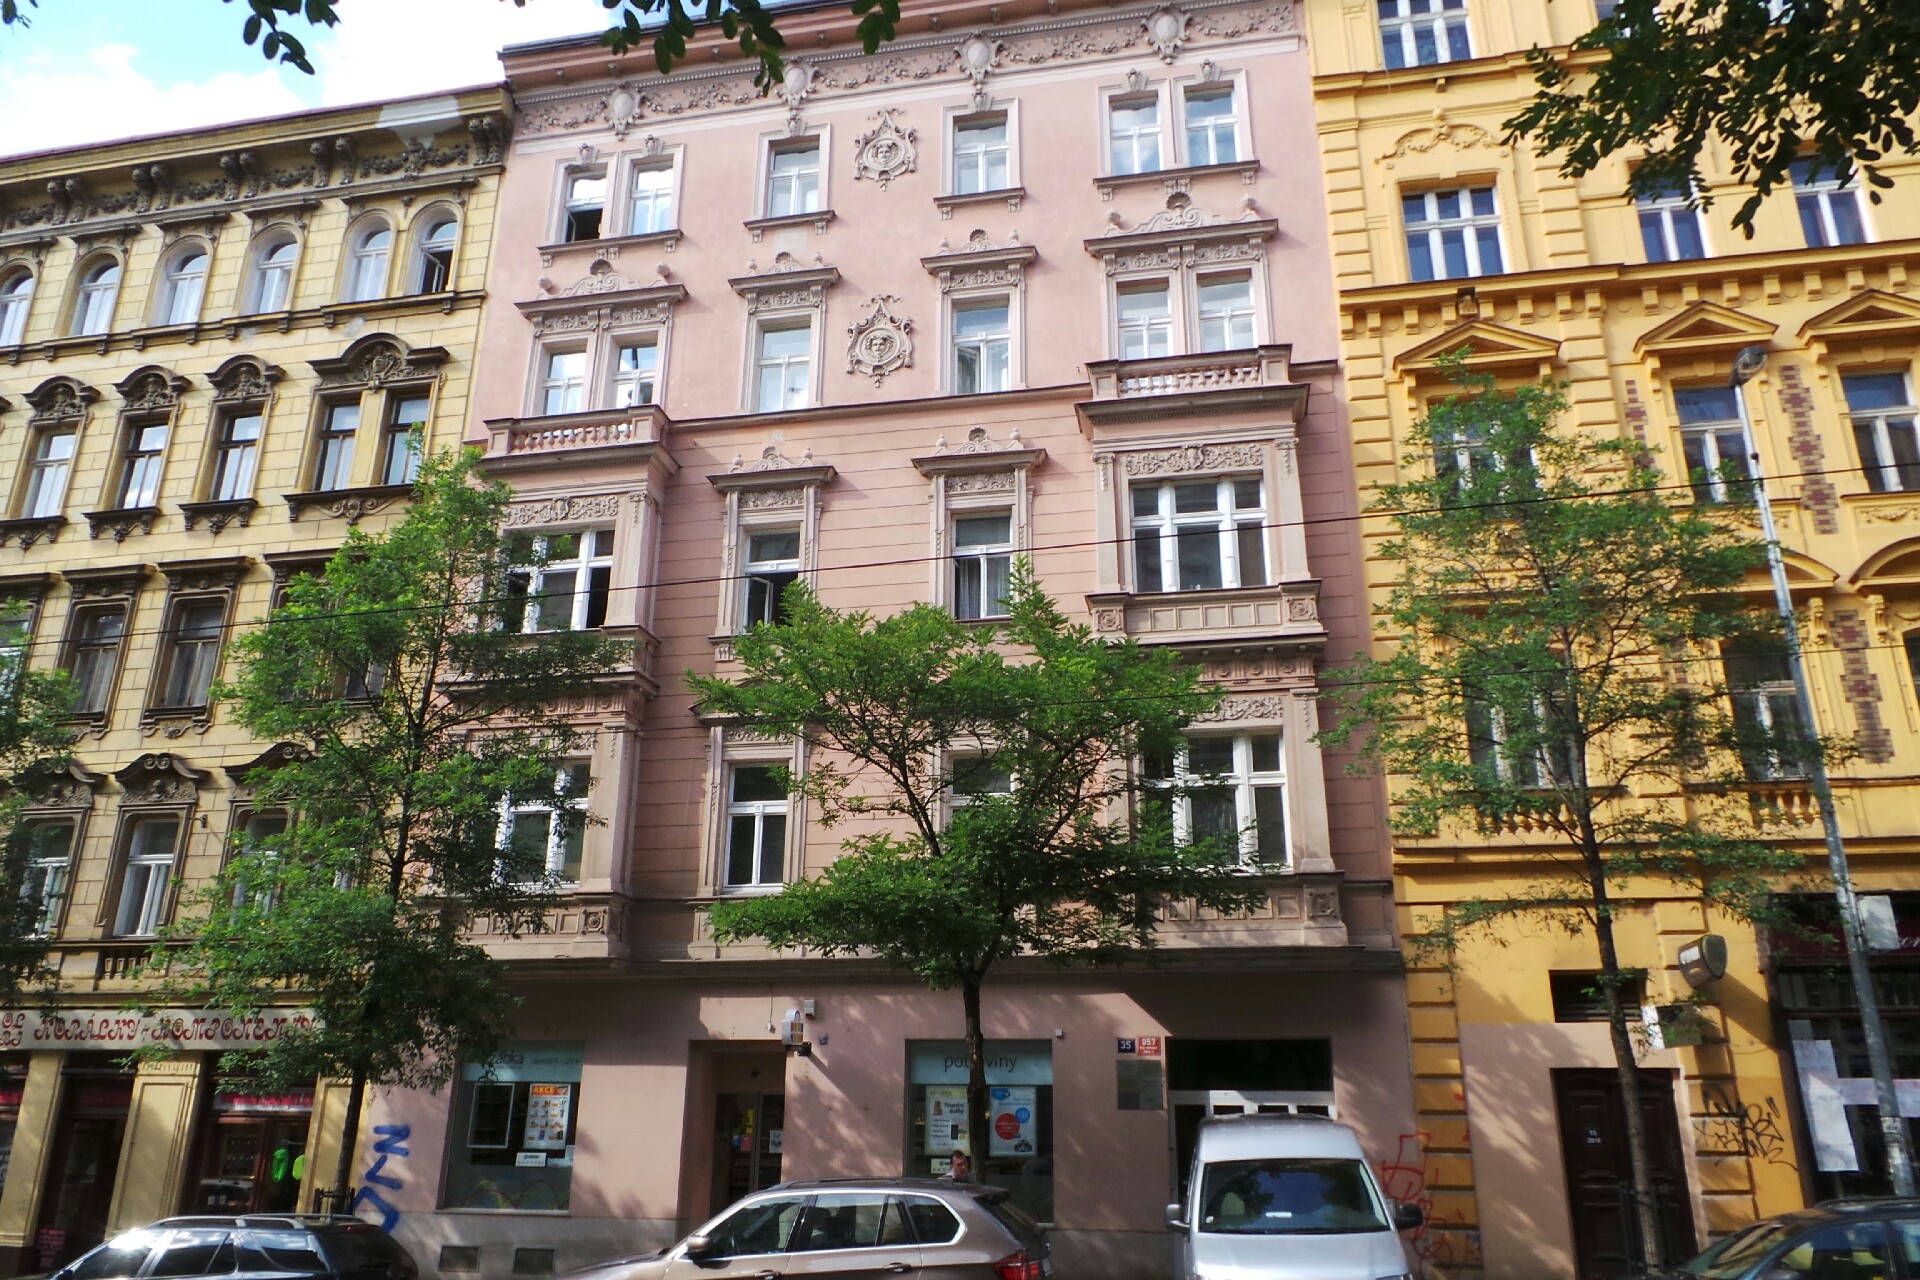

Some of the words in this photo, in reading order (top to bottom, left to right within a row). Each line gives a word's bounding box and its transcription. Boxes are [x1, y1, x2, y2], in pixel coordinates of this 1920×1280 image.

[1120, 1040, 1132, 1050] 35
[944, 1052, 1017, 1073] potviny
[532, 1085, 555, 1094] AKCE
